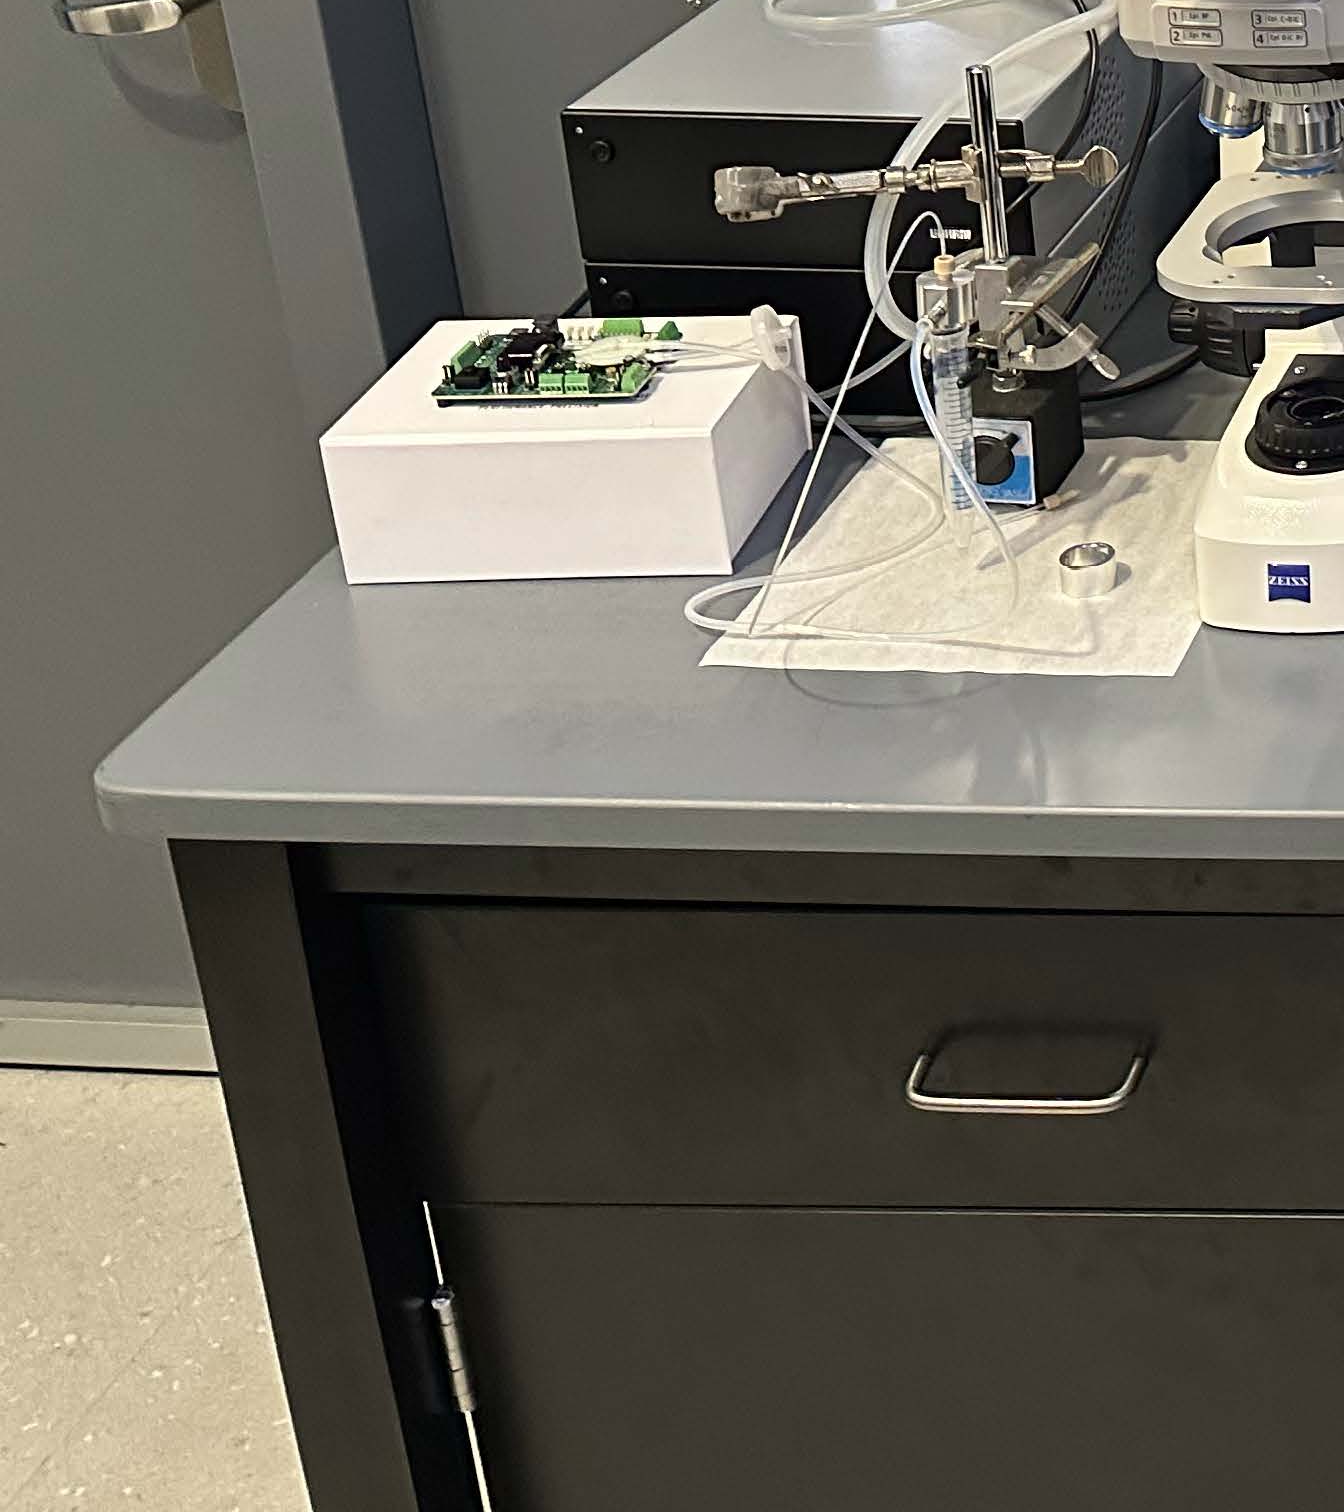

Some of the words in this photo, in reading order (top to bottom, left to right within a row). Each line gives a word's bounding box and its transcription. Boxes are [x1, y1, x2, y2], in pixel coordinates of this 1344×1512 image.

[1172, 12, 1178, 22] 1
[1254, 14, 1262, 25] 3
[1173, 31, 1180, 42] 2
[1256, 34, 1264, 44] 4
[1268, 575, 1309, 586] ZEISS
